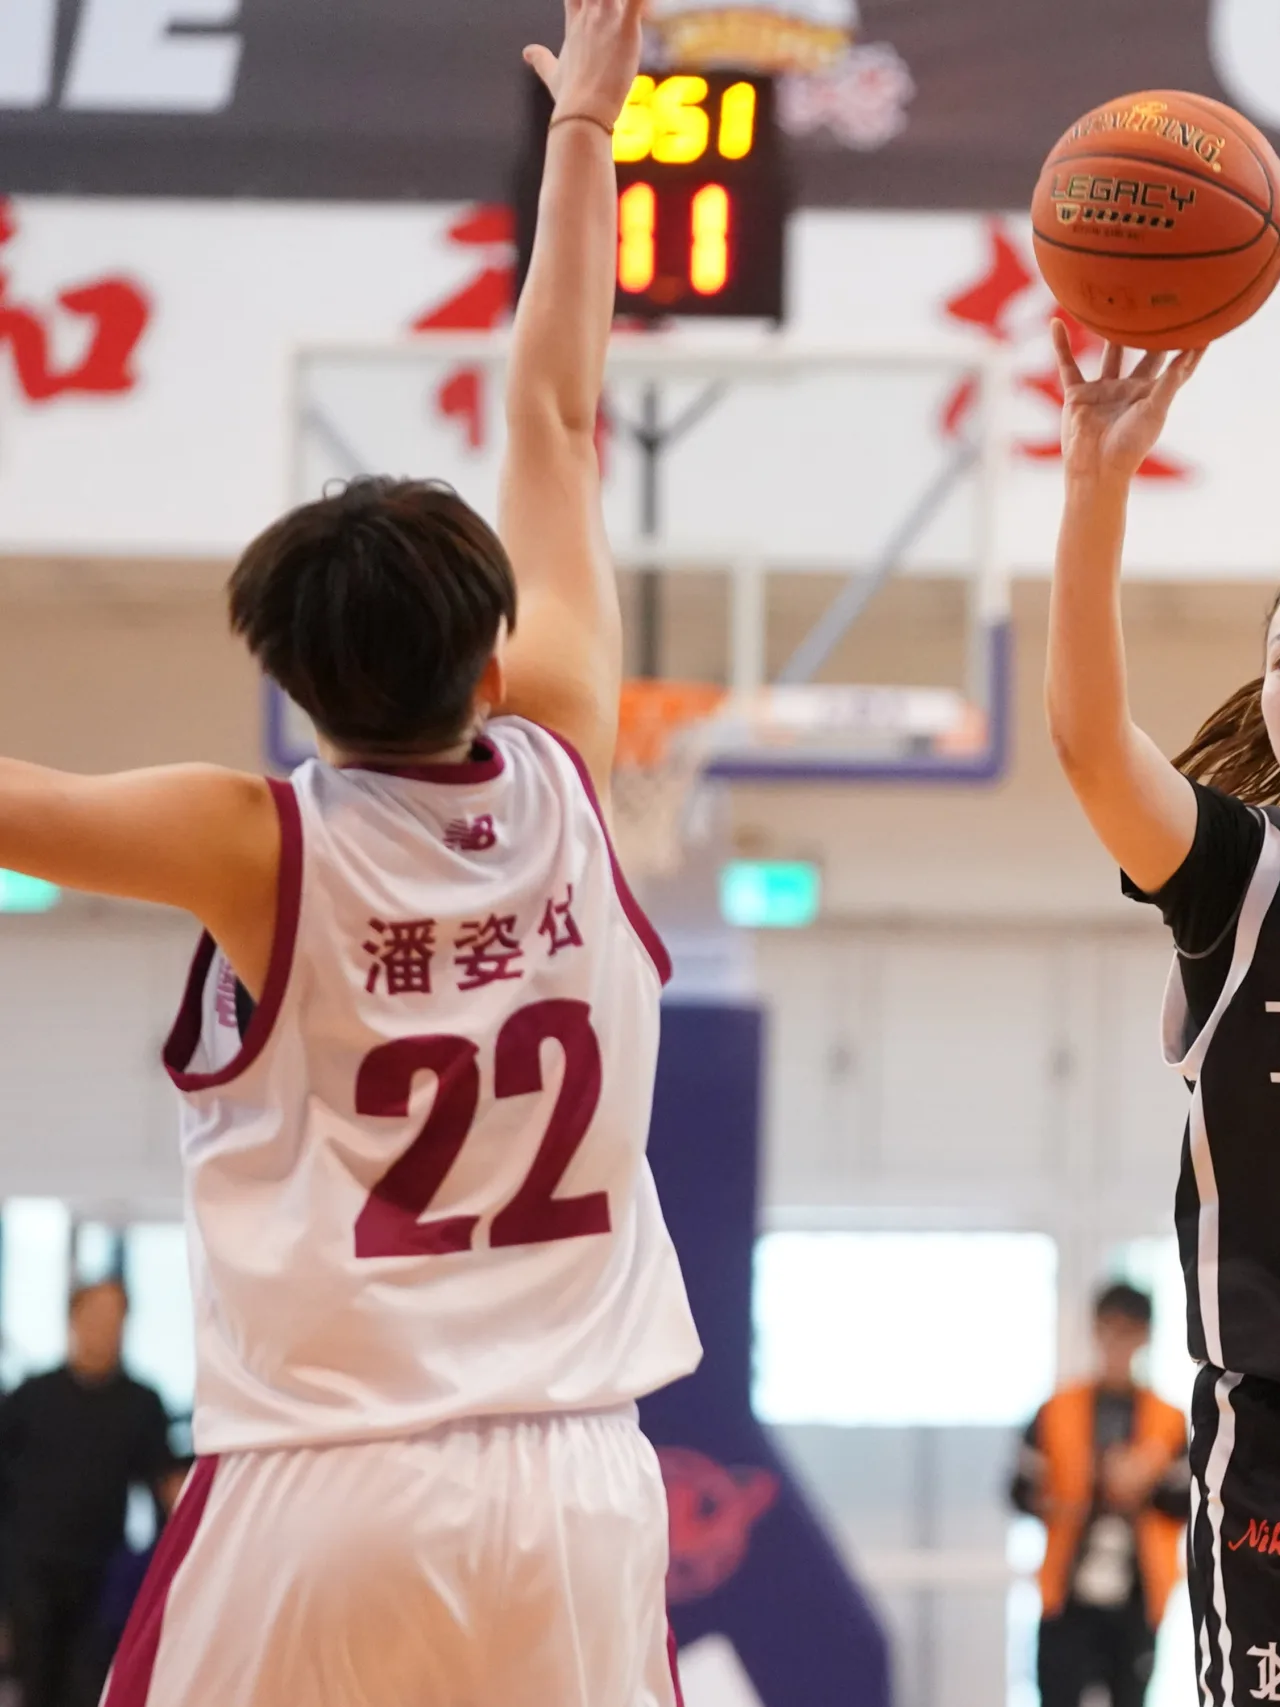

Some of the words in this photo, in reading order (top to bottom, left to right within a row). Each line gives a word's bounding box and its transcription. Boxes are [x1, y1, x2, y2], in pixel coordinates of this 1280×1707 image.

[618, 182, 730, 294] 11
[1051, 174, 1197, 212] LEGACY
[354, 998, 612, 1259] 22
